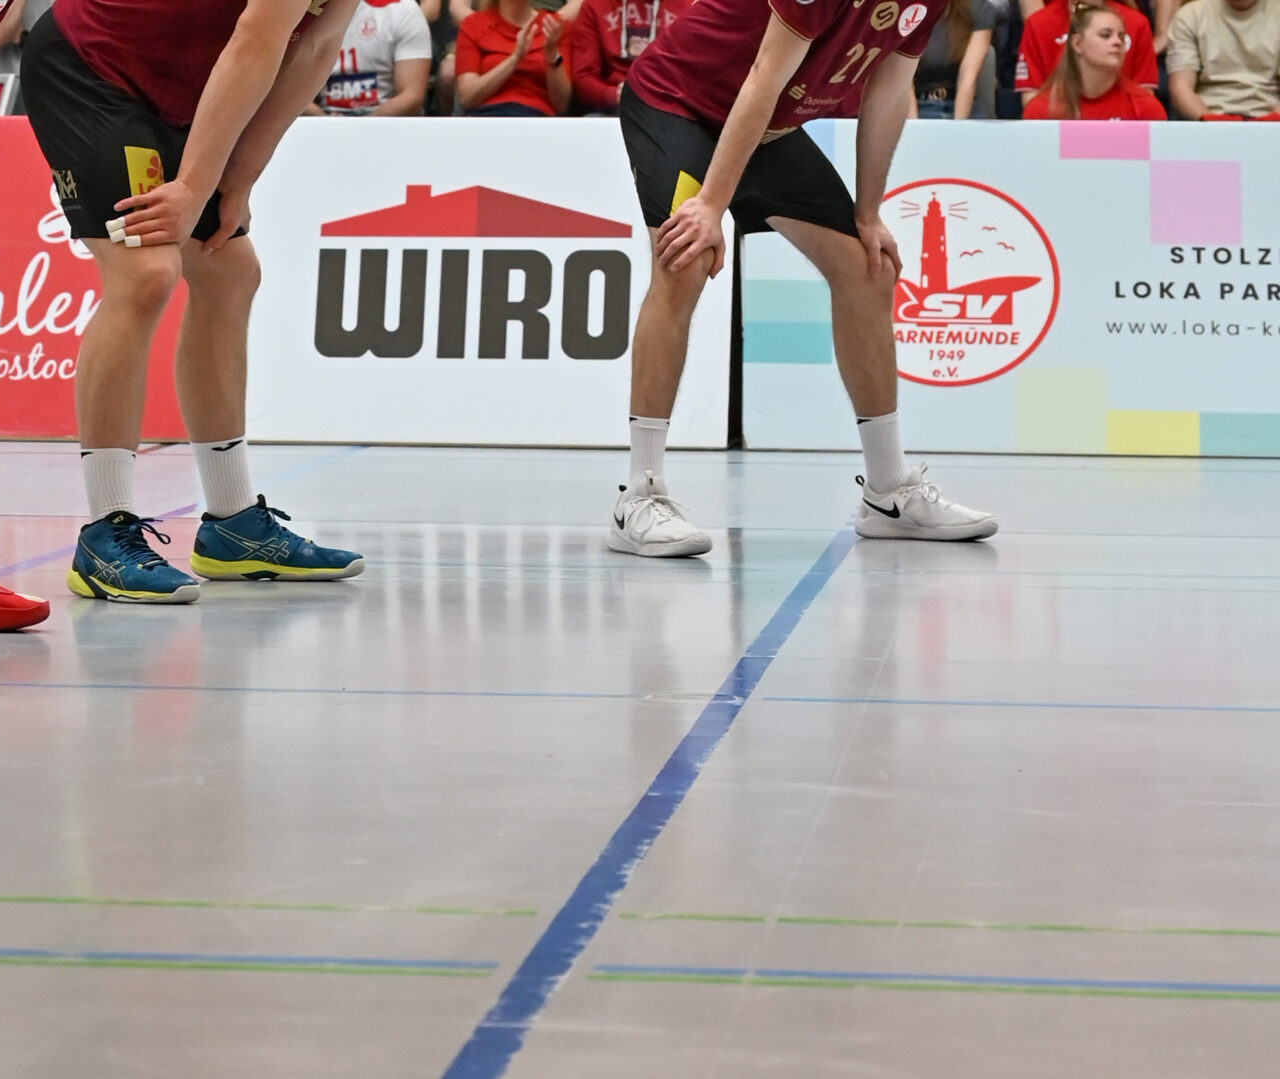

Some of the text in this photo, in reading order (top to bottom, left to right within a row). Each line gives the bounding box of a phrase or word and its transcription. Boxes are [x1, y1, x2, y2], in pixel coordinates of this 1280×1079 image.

[338, 46, 358, 74] 11
[828, 42, 882, 85] 21
[1170, 246, 1280, 265] STOLZ
[1114, 281, 1280, 301] LOKA PAR
[314, 248, 632, 360] WIRO
[894, 326, 1020, 345] ARNEMÜNDE
[1105, 319, 1280, 337] www.loka-k
[928, 349, 966, 361] 1949
[932, 366, 959, 378] e.V.
